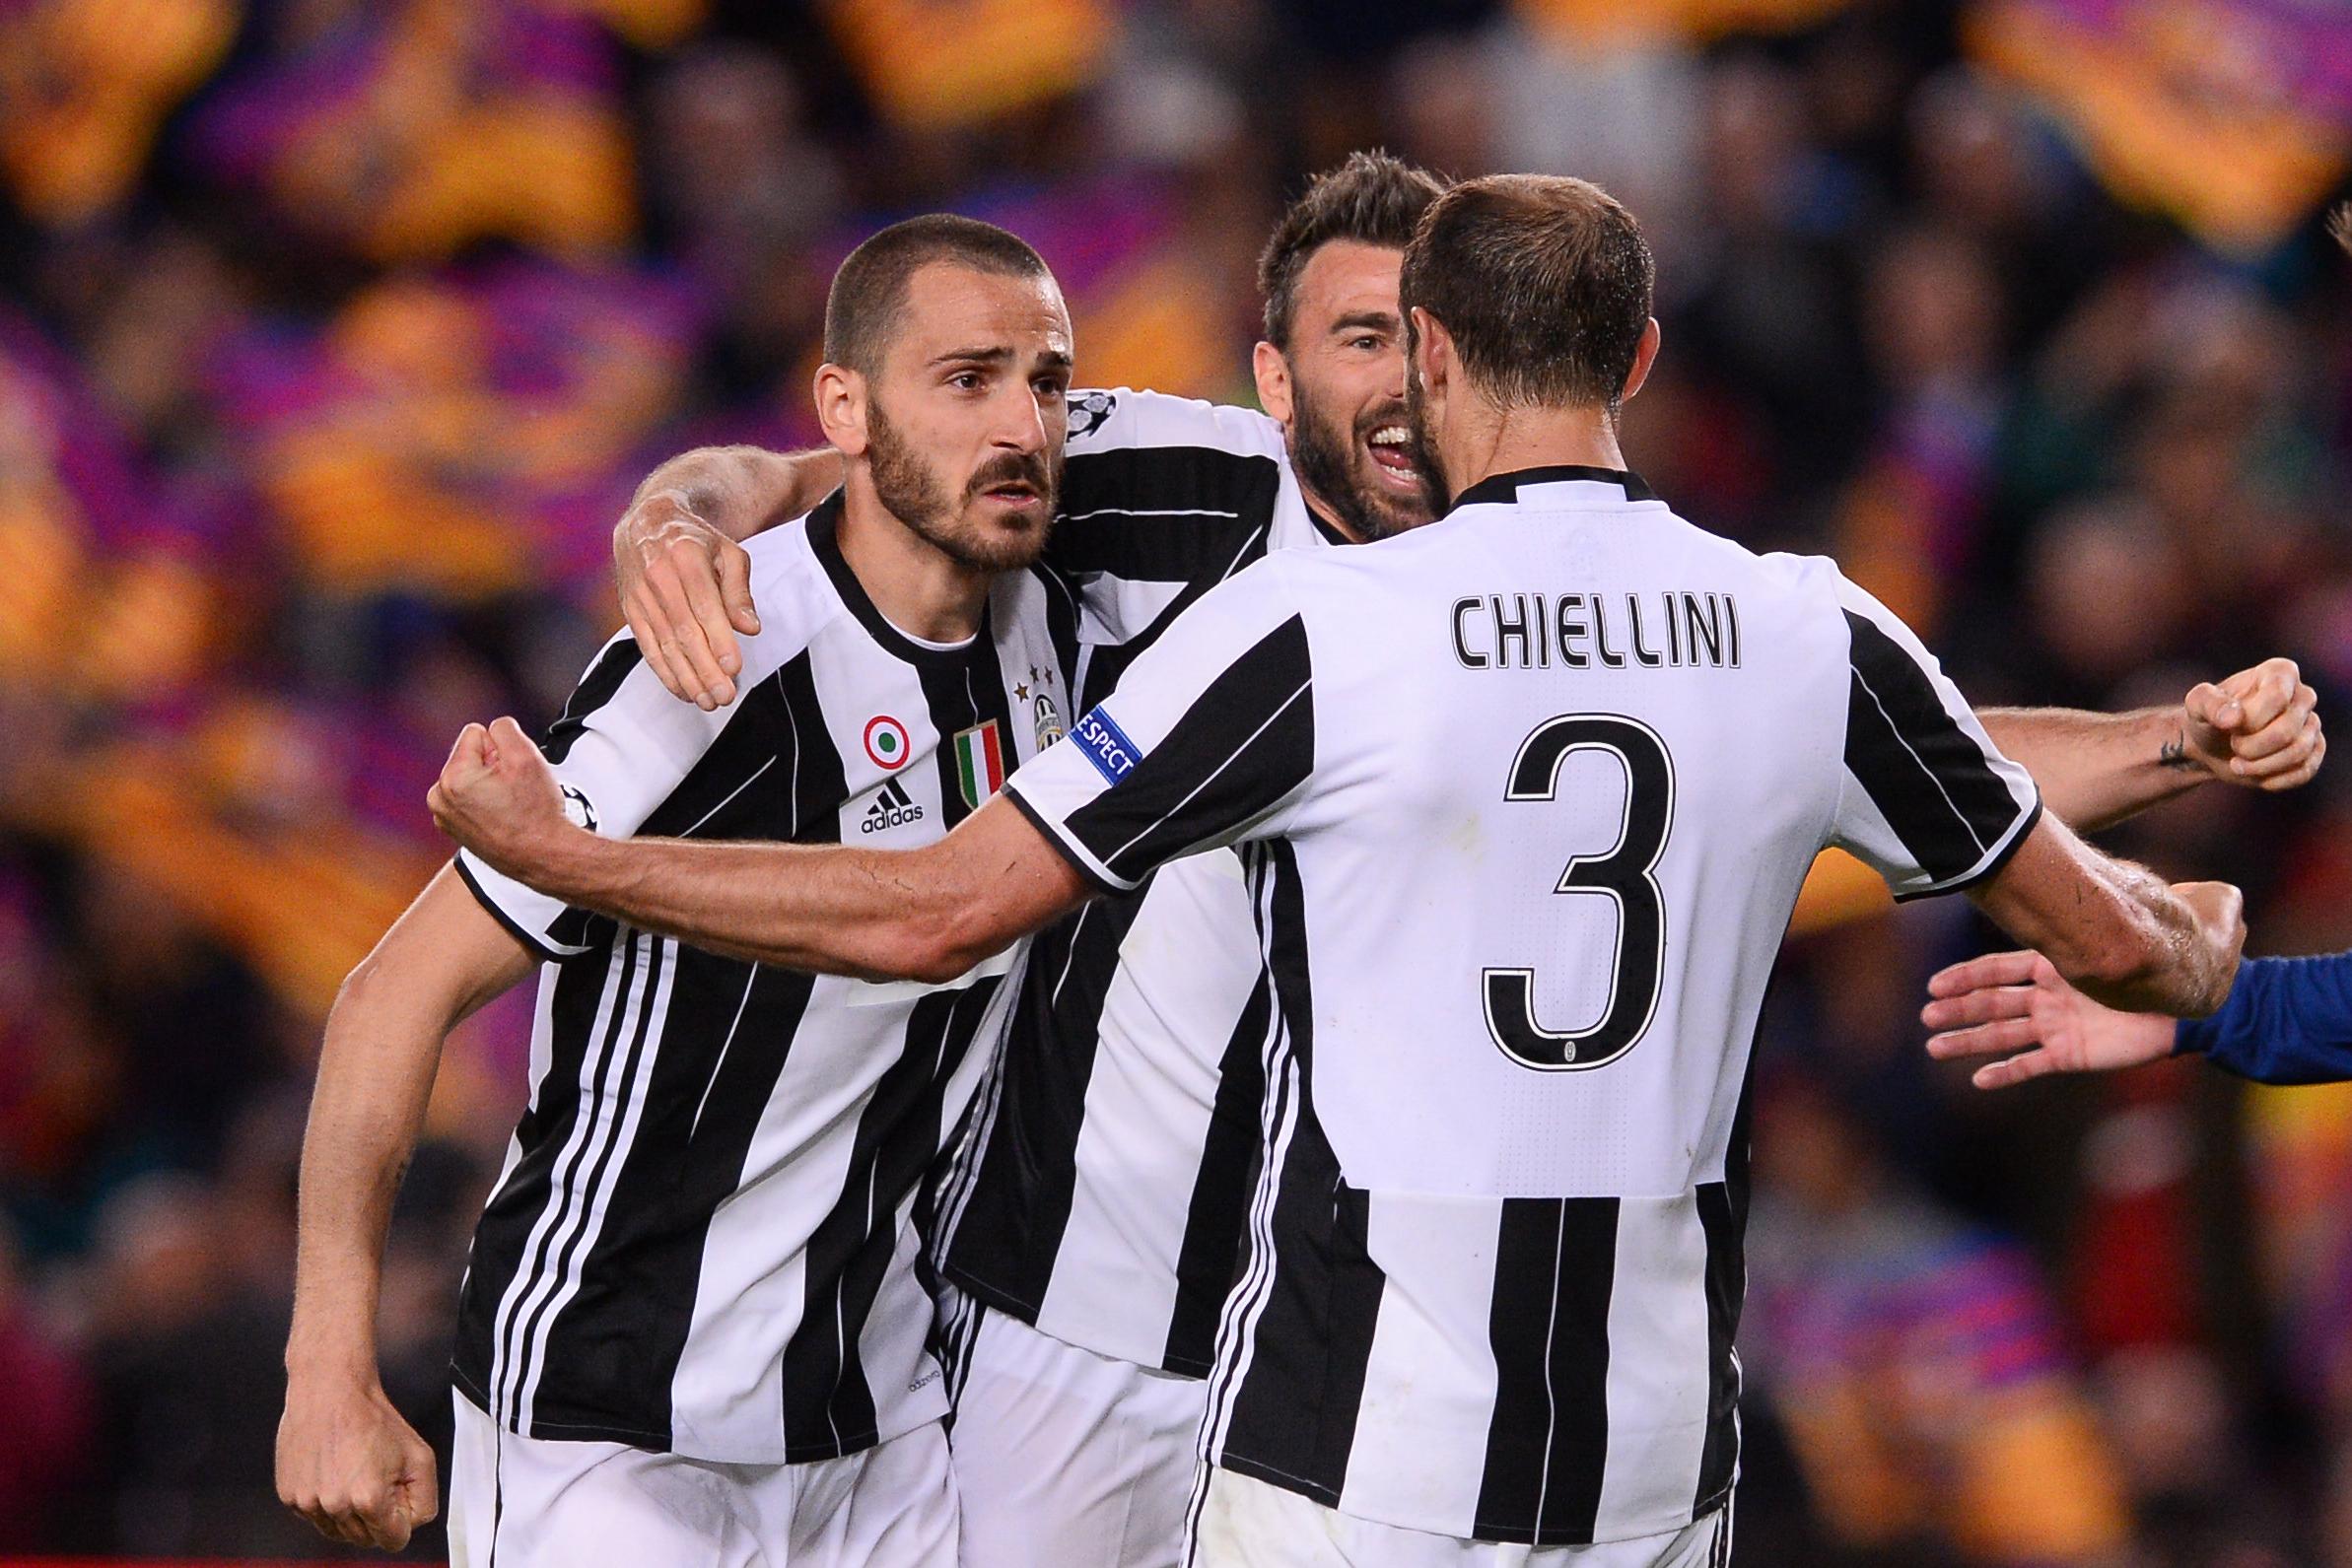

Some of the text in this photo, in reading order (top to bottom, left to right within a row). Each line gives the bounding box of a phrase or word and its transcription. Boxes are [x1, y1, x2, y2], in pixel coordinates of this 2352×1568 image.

[1450, 591, 1742, 670] CHIELLINI
[1075, 713, 1135, 776] ESPECT
[861, 805, 924, 834] adidas
[1482, 712, 1677, 1072] 3
